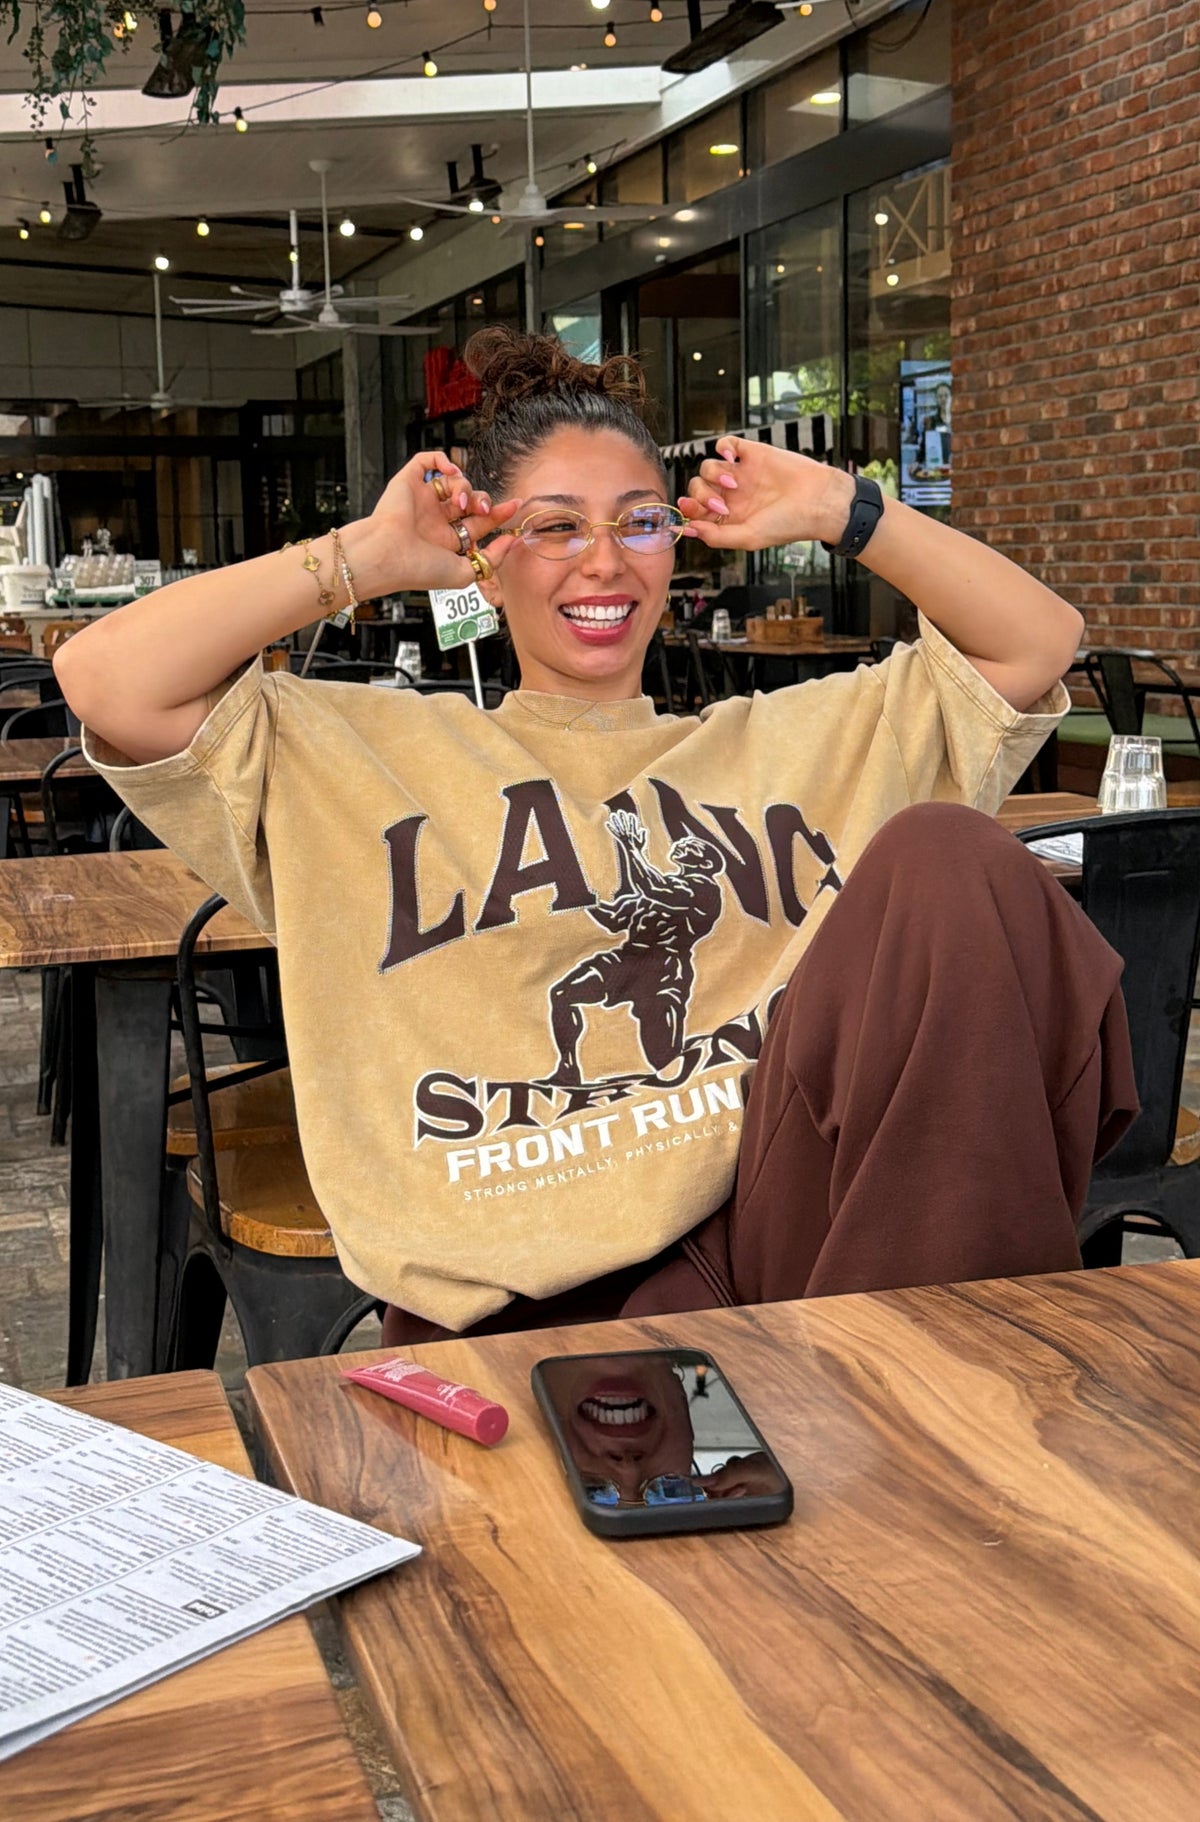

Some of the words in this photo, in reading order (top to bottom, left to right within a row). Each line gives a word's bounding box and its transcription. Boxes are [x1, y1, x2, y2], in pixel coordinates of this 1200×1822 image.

[445, 590, 480, 620] 305
[447, 1114, 620, 1183] FRONT
[464, 1181, 527, 1202] STRONG
[535, 1157, 618, 1188] MENTALLY,
[728, 1121, 738, 1133] &
